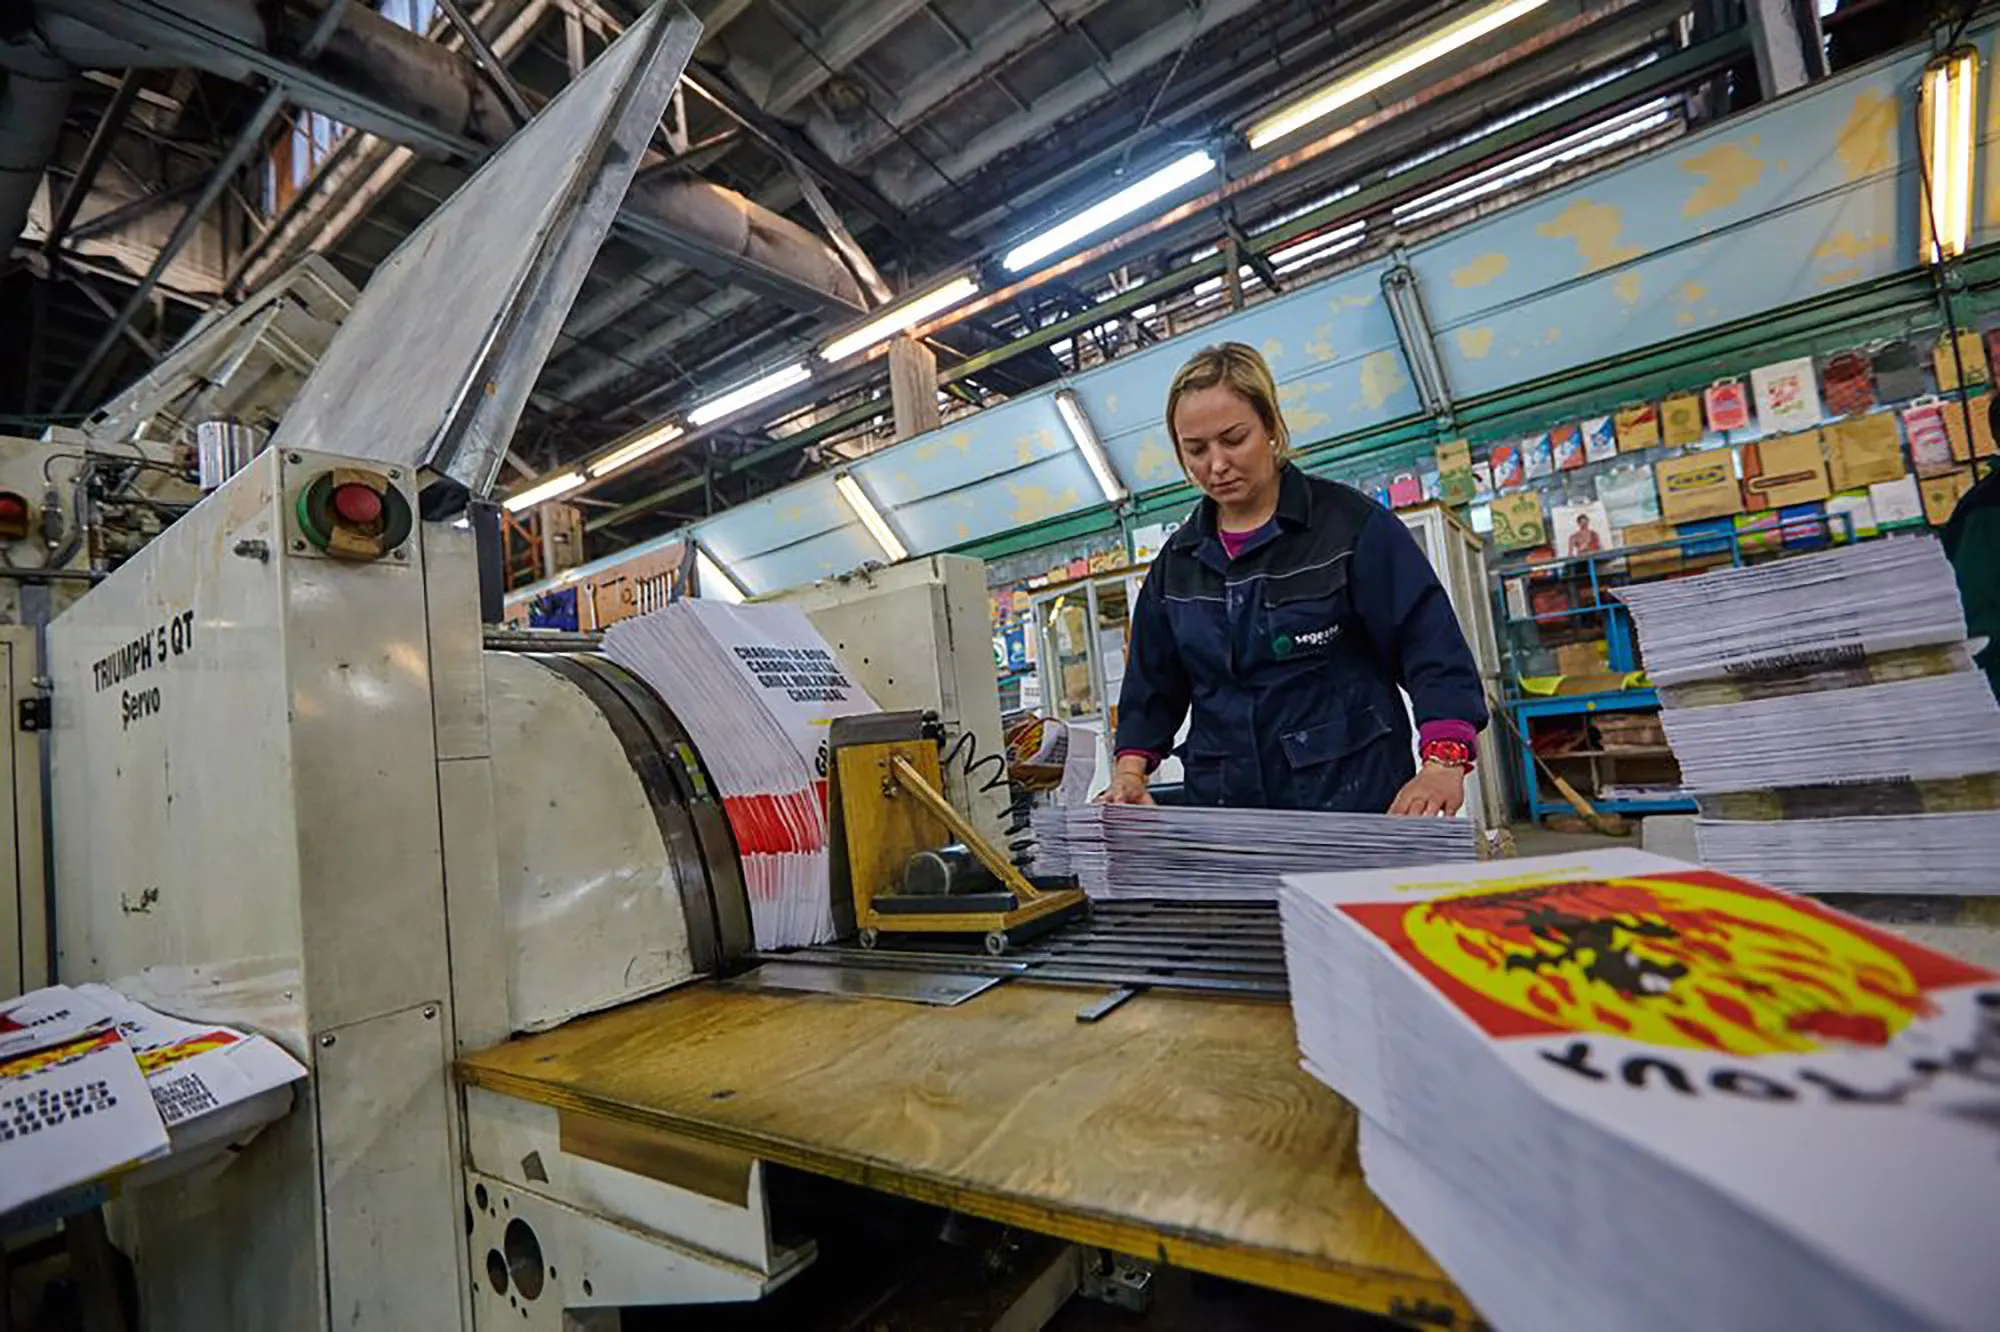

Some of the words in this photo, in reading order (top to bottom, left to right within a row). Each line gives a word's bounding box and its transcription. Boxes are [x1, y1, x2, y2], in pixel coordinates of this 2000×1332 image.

[93, 631, 152, 693] TRIUMPH
[157, 625, 168, 662] 5
[171, 610, 194, 656] QT
[122, 688, 161, 721] Servo
